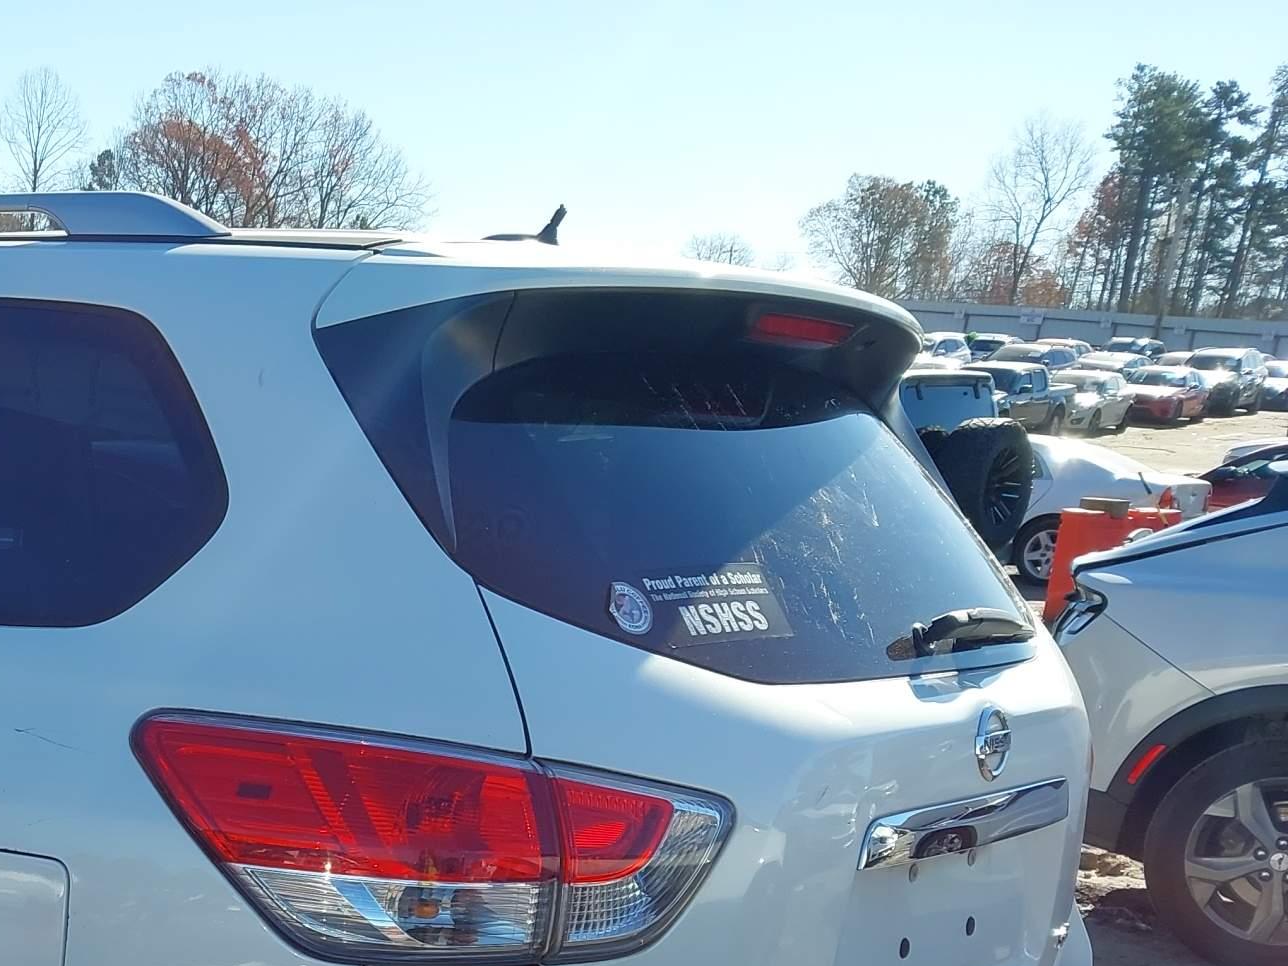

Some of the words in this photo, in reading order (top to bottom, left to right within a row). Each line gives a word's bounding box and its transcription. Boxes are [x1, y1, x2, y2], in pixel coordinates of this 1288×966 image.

[643, 577, 675, 591] Proud
[675, 574, 710, 588] Parent
[710, 573, 722, 585] of
[721, 575, 730, 585] a
[727, 572, 762, 585] Scholar
[679, 601, 769, 636] NSHSS
